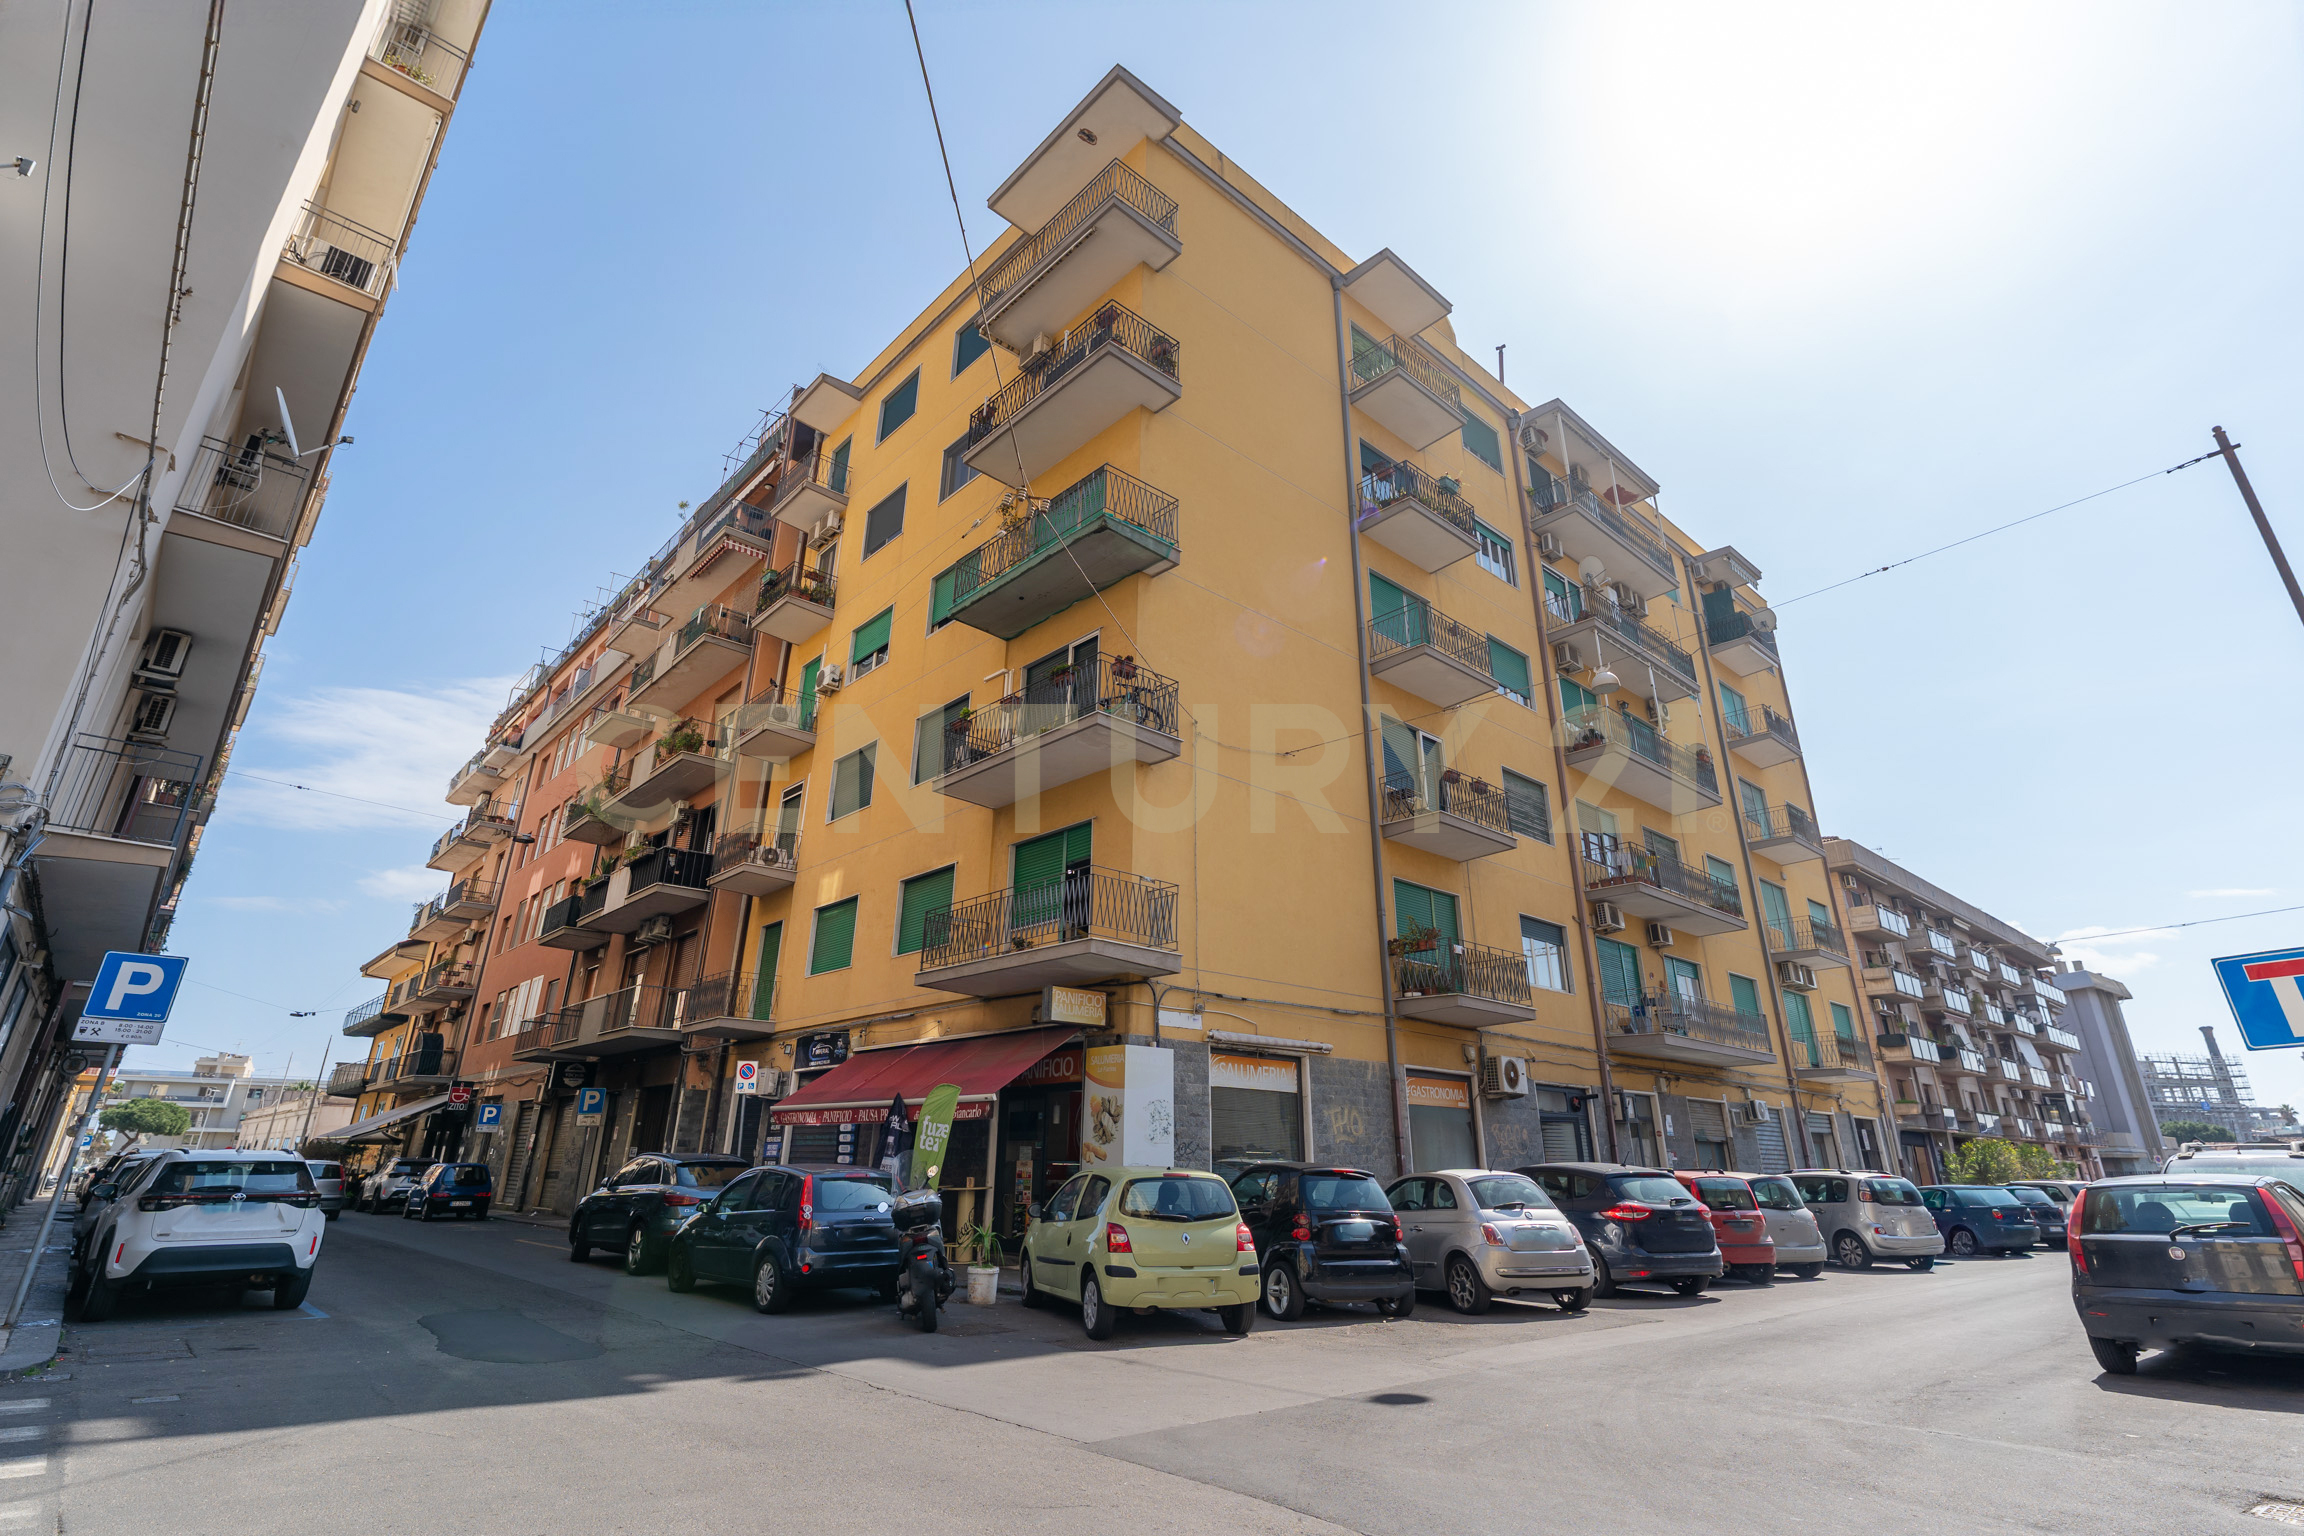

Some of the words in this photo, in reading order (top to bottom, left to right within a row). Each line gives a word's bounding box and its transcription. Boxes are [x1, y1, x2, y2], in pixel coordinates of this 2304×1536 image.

[105, 961, 164, 1010] P
[1055, 990, 1102, 1007] PANIFICIO
[1053, 1003, 1103, 1018] SALUMERIA
[1090, 1053, 1125, 1065] SALUMERIA
[1018, 1057, 1073, 1080] ANIFICIO
[1219, 1062, 1287, 1080] SALUMERIA
[583, 1091, 600, 1111] P
[1410, 1085, 1464, 1100] GASTRONOMIA
[483, 1107, 497, 1122] P
[780, 1110, 817, 1124] GASTRONOMIA
[822, 1110, 852, 1123] PANIFICIO
[858, 1109, 878, 1121] PAUSA
[922, 1115, 949, 1139] fuze
[920, 1135, 940, 1152] tea
